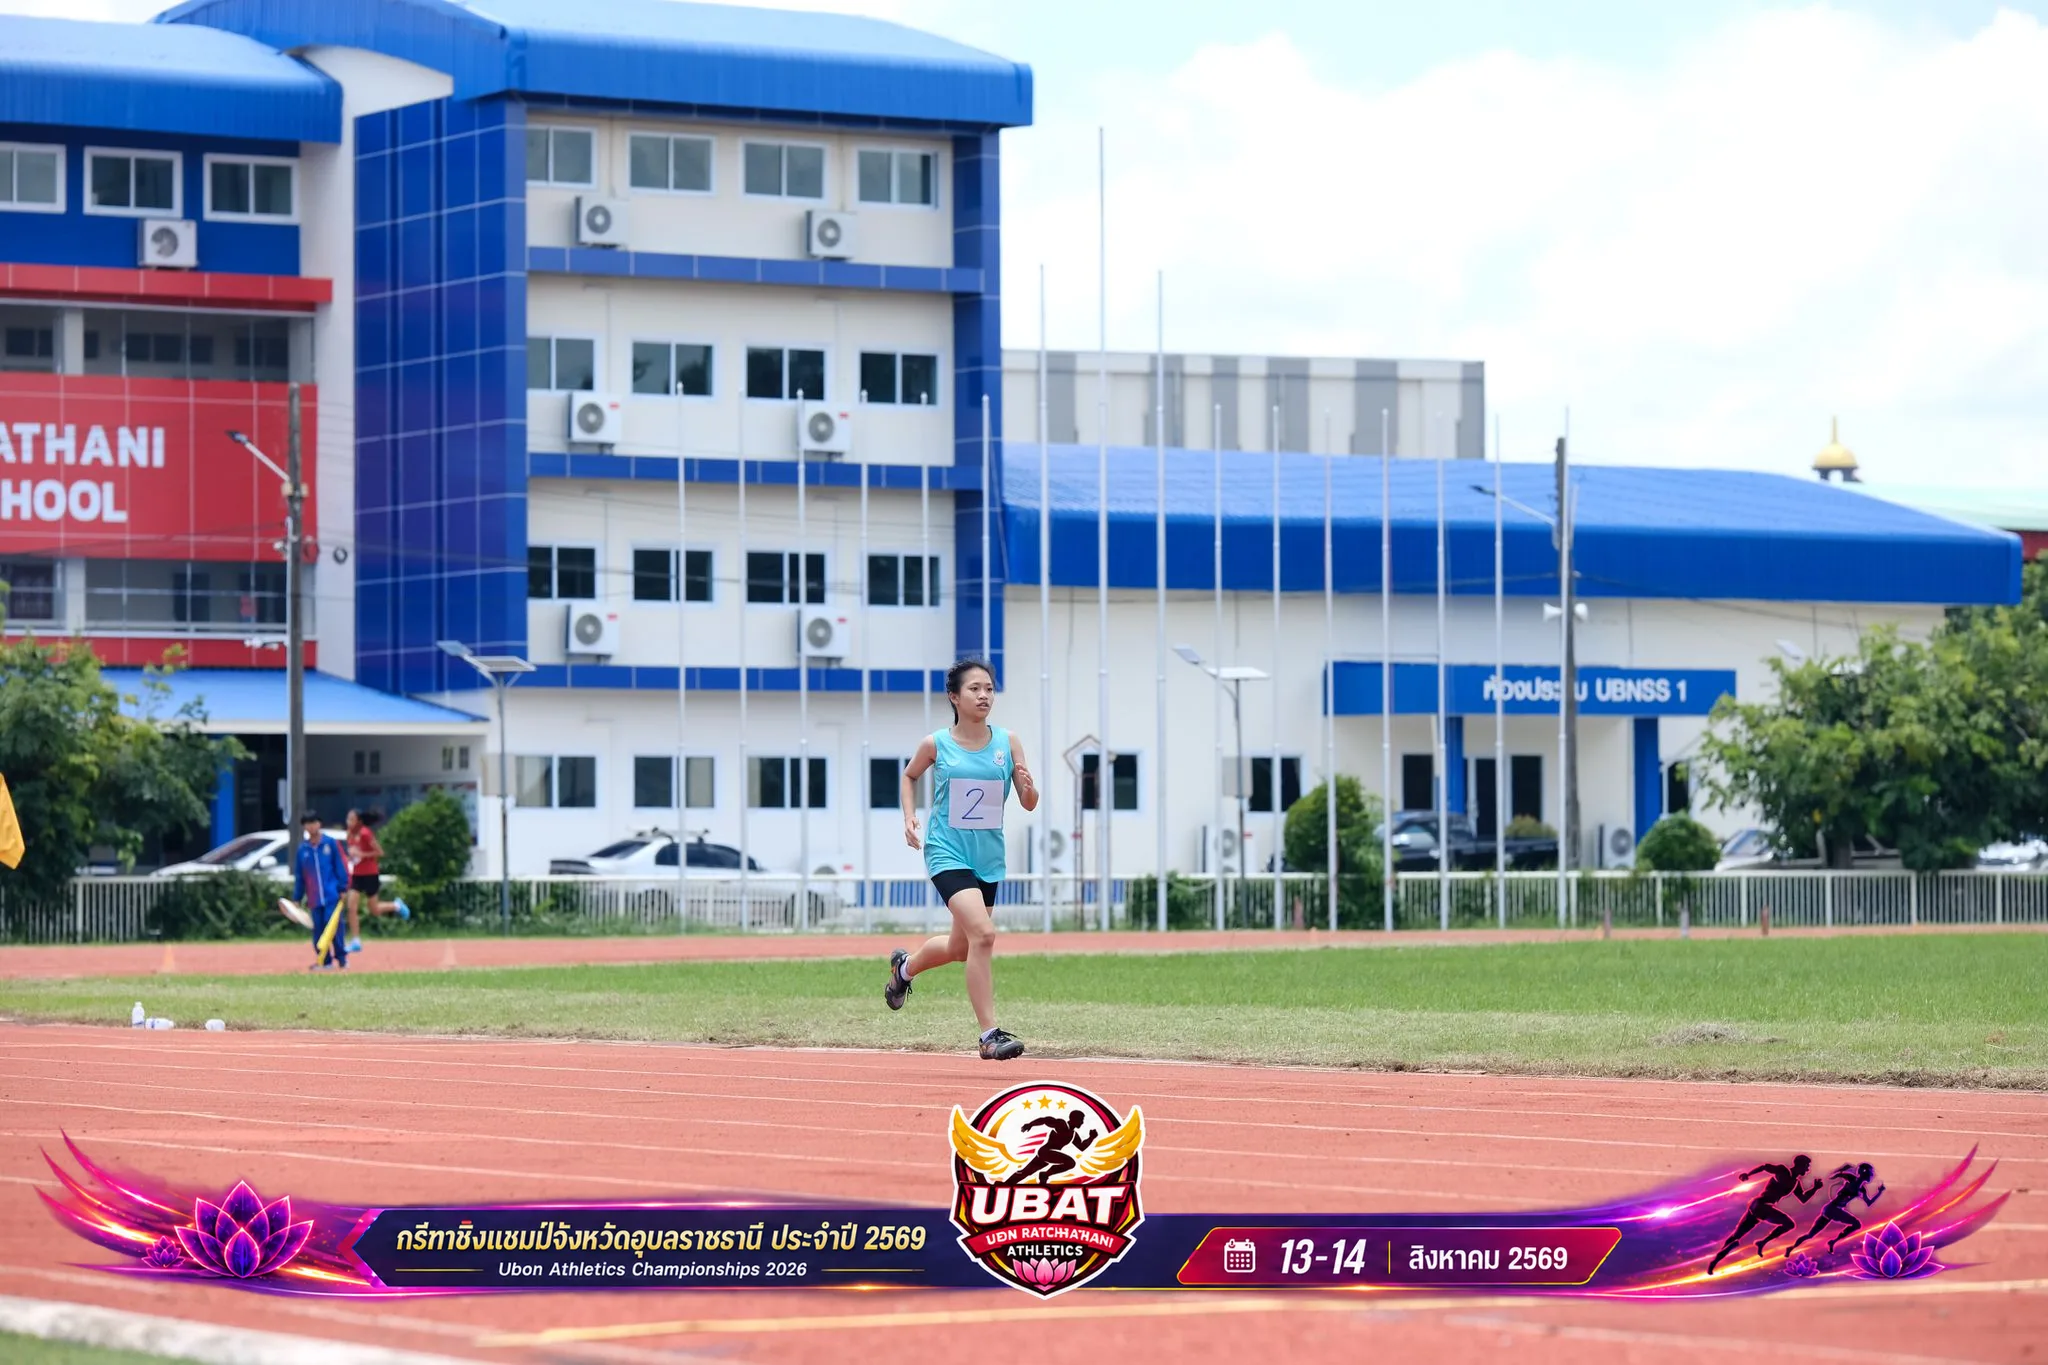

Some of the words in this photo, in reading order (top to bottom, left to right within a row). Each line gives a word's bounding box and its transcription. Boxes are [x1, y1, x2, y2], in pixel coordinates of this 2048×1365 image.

[1595, 678, 1671, 702] UBNSS
[1676, 679, 1687, 702] 1
[961, 788, 985, 820] 2
